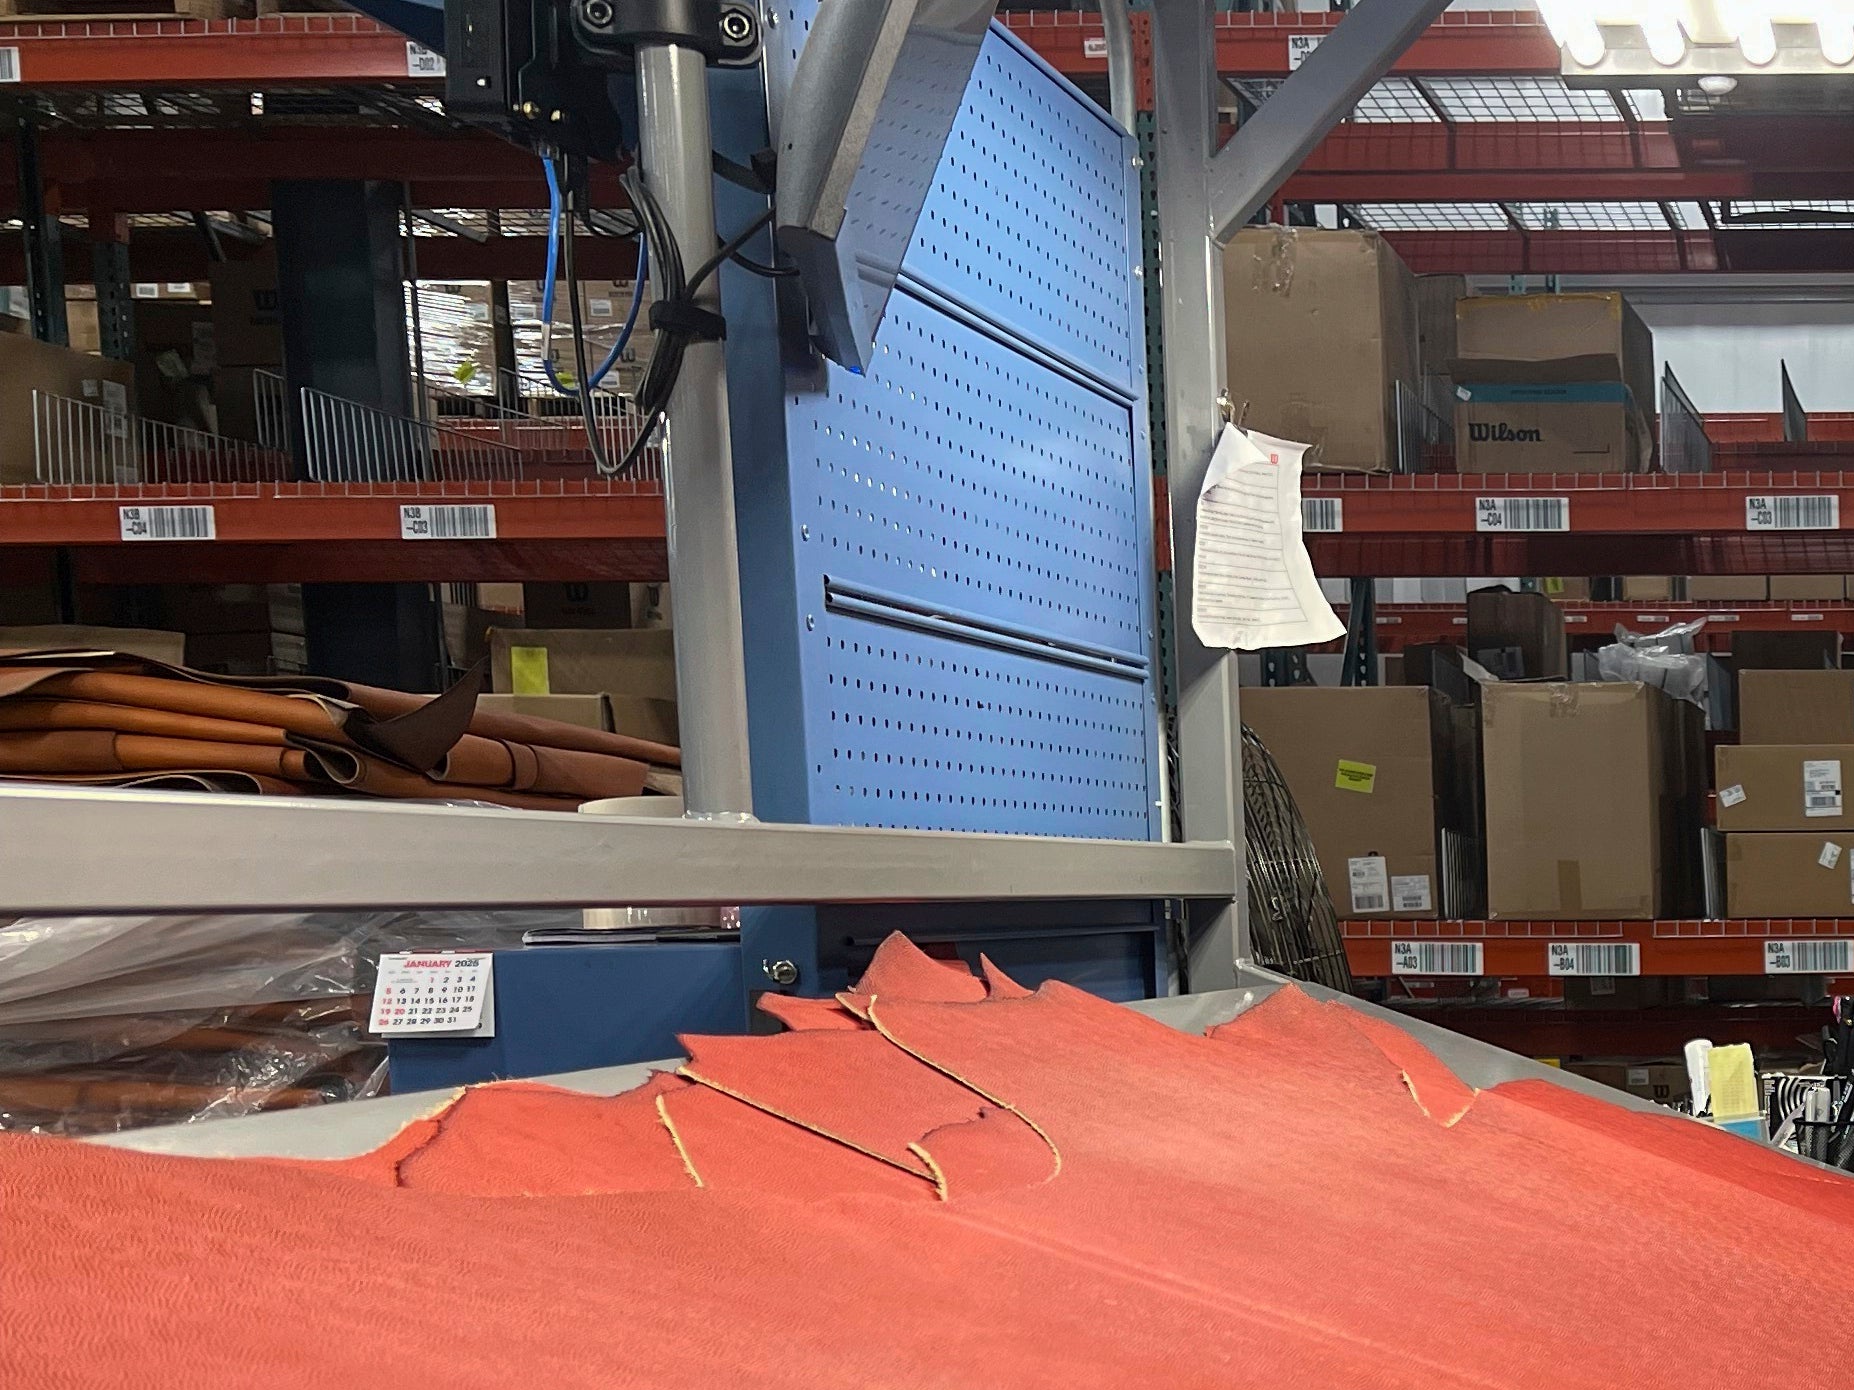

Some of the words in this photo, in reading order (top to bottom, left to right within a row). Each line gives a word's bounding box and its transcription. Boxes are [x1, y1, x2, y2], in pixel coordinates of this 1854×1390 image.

[1291, 37, 1309, 49] N3A
[1468, 422, 1543, 442] Wilson
[1479, 499, 1496, 510] N3A
[1749, 498, 1766, 509] N3A
[123, 508, 140, 520] N3B
[403, 507, 421, 518] N3B
[1394, 943, 1411, 954] N3A
[1551, 945, 1568, 955] N3A
[1767, 943, 1784, 953] N3A
[403, 960, 452, 968] JANUARY
[1396, 956, 1418, 969] -A03
